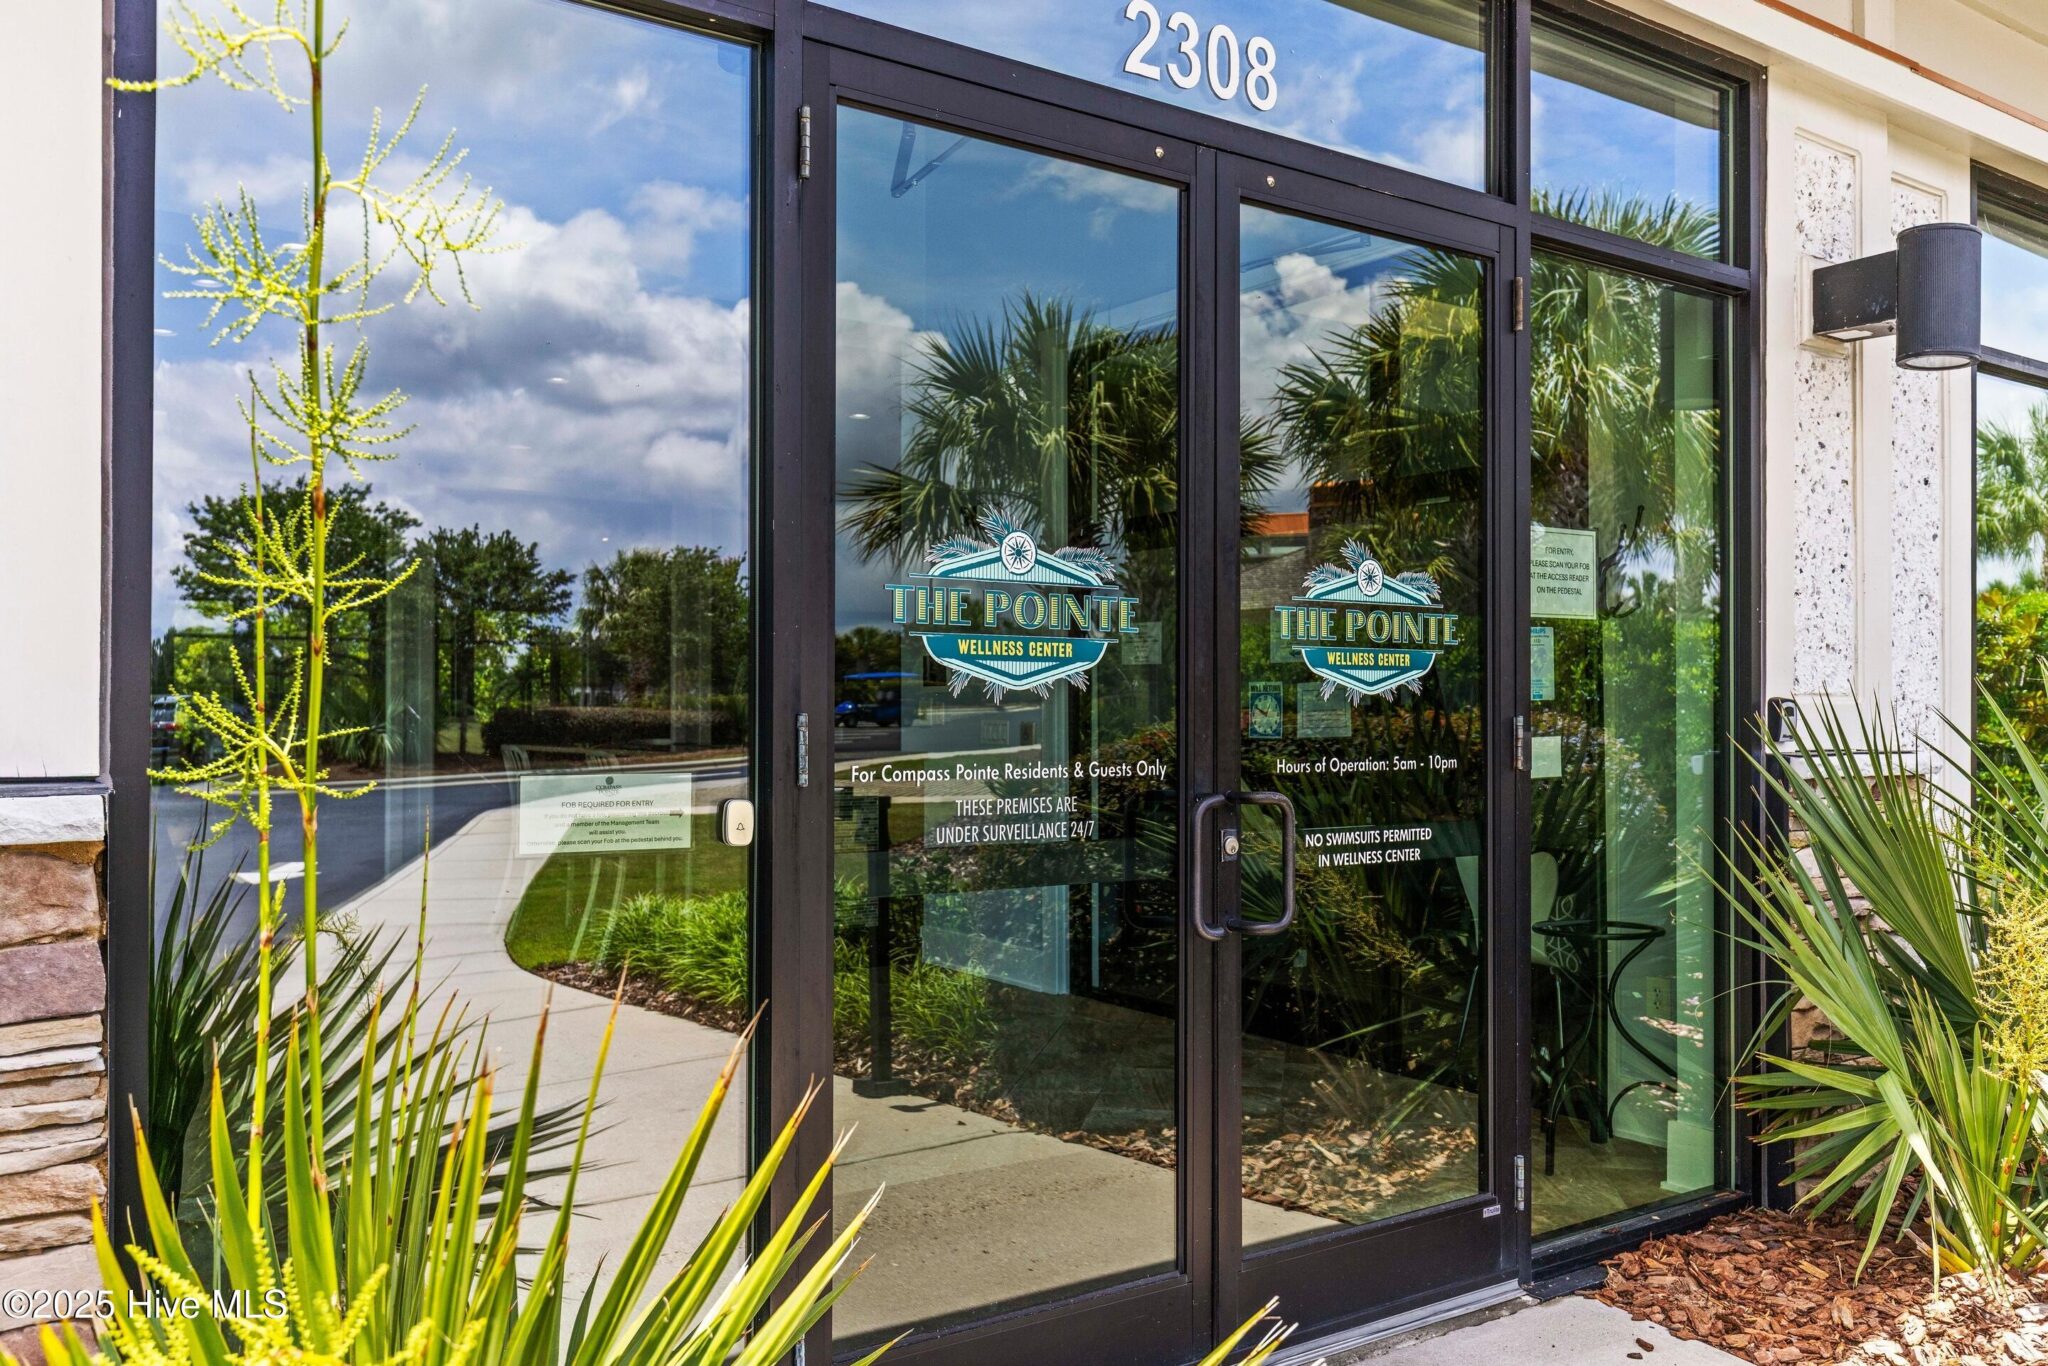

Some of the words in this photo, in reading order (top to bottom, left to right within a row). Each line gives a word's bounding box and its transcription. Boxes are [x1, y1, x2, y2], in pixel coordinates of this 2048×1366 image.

[1123, 0, 1278, 111] 2308
[1545, 547, 1556, 555] FOR
[1549, 561, 1563, 569] SCAN
[1563, 562, 1579, 570] YOUR
[1579, 562, 1590, 571] FOB
[1537, 572, 1548, 580] THE
[1548, 573, 1568, 581] ACCESS
[1569, 574, 1590, 582] READER
[1536, 586, 1546, 594] ON
[1546, 586, 1557, 594] THE
[1557, 586, 1583, 596] PEDESTAL
[884, 584, 972, 626] THE
[984, 590, 1140, 634] POINTE
[1275, 605, 1337, 641] THE
[1346, 609, 1459, 646] POINTE
[957, 638, 1024, 657] WELLNESS
[1029, 641, 1073, 658] CENTER
[1327, 651, 1375, 667] WELLNESS
[1378, 653, 1411, 667] CENTER
[851, 765, 876, 783] For
[881, 764, 950, 787] Compass
[956, 763, 1000, 782] Pointe
[1004, 760, 1069, 781] Residents
[1073, 760, 1084, 778] &
[1089, 761, 1132, 778] Guests
[1136, 759, 1167, 781] Only
[1276, 758, 1311, 774] Hours
[1315, 756, 1327, 773] of
[1330, 756, 1389, 777] Operation:
[1393, 755, 1417, 771] 5am
[1428, 754, 1458, 774] 10pm
[561, 801, 577, 809] FOB
[577, 800, 615, 809] REQUIRED
[615, 800, 631, 808] FOR
[631, 799, 655, 807] ENTRY
[955, 799, 993, 817] THESE
[996, 797, 1053, 816] PREMISES
[1056, 796, 1078, 813] ARE
[936, 826, 979, 845] UNDER
[982, 822, 1068, 843] SURVEILLANCE
[1070, 820, 1095, 840] 24/7
[1305, 833, 1324, 848] NO
[1326, 830, 1381, 847] SWIMSUITS
[1383, 827, 1432, 843] PERMITTED
[1318, 853, 1330, 868] IN
[1333, 850, 1382, 867] WELLNESS
[1385, 848, 1421, 863] CENTER
